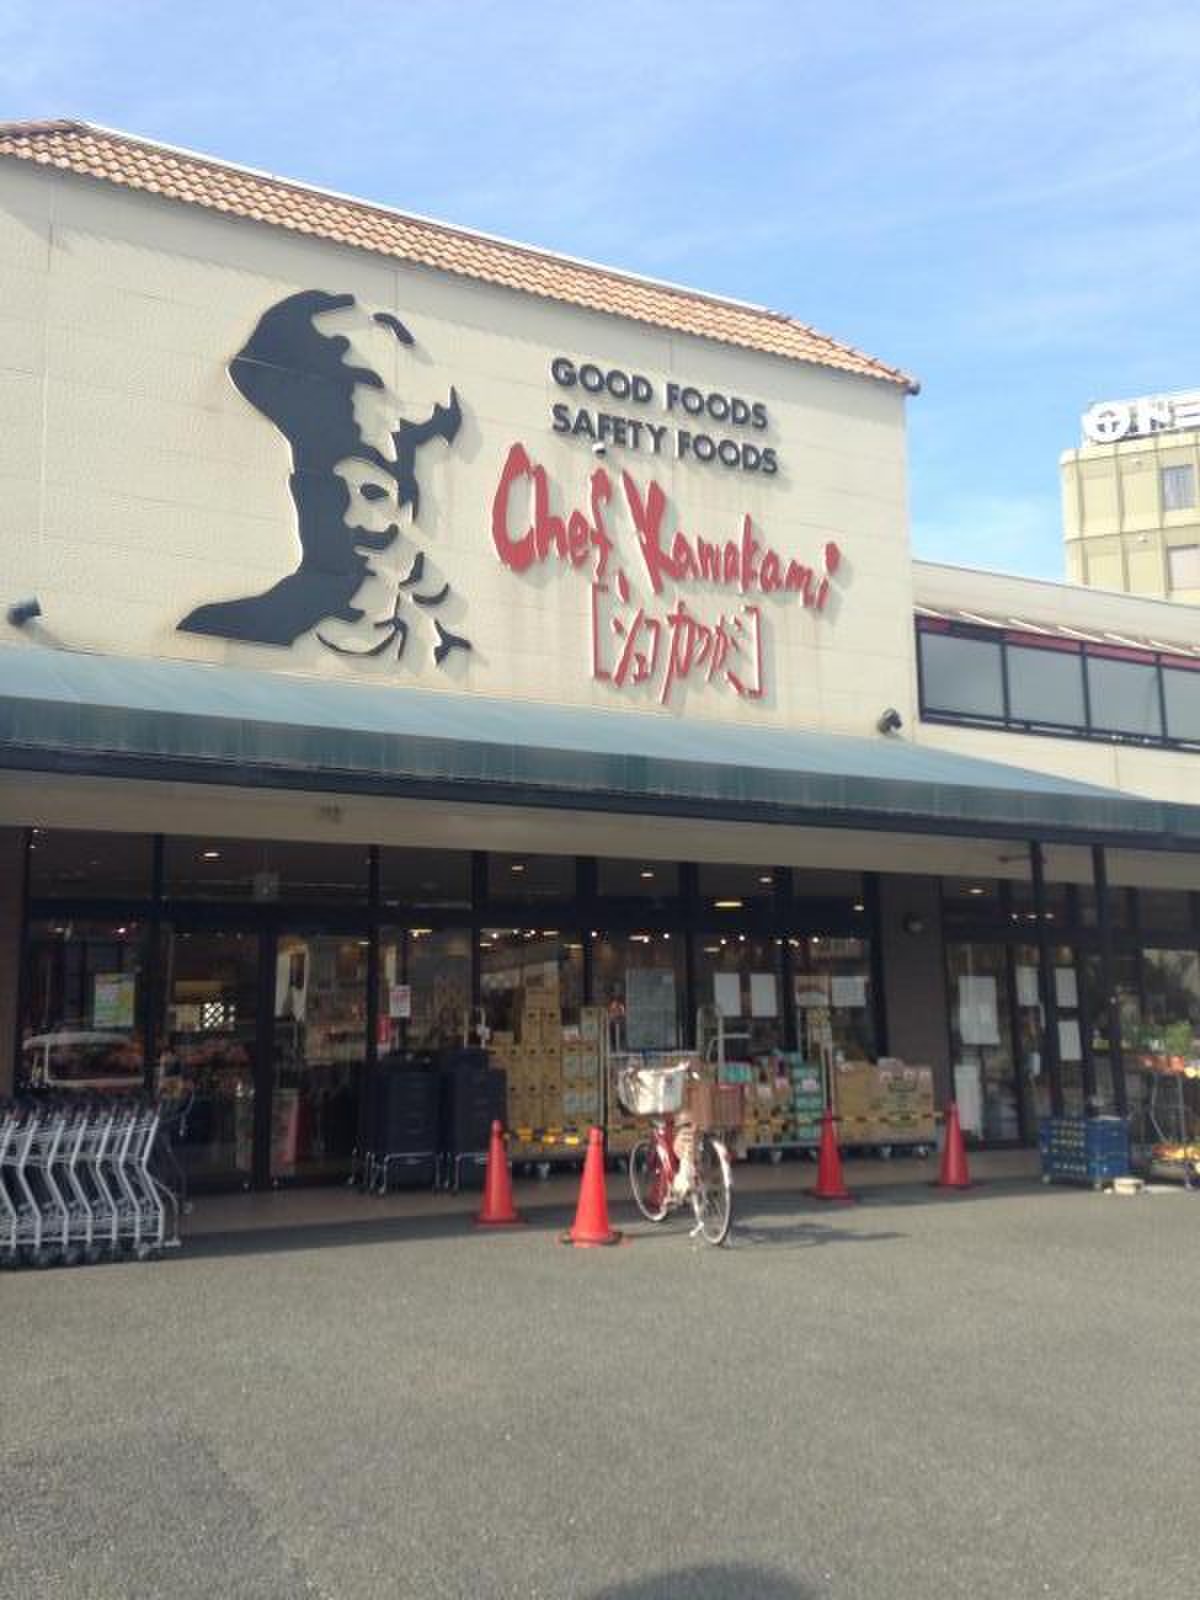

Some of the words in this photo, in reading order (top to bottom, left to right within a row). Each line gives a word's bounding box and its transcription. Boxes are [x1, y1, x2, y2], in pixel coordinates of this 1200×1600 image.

[551, 357, 653, 402] GOOD
[666, 382, 768, 431] FOODS
[552, 403, 667, 455] SAFETY
[678, 431, 779, 475] FOODS
[492, 442, 613, 584] Chef
